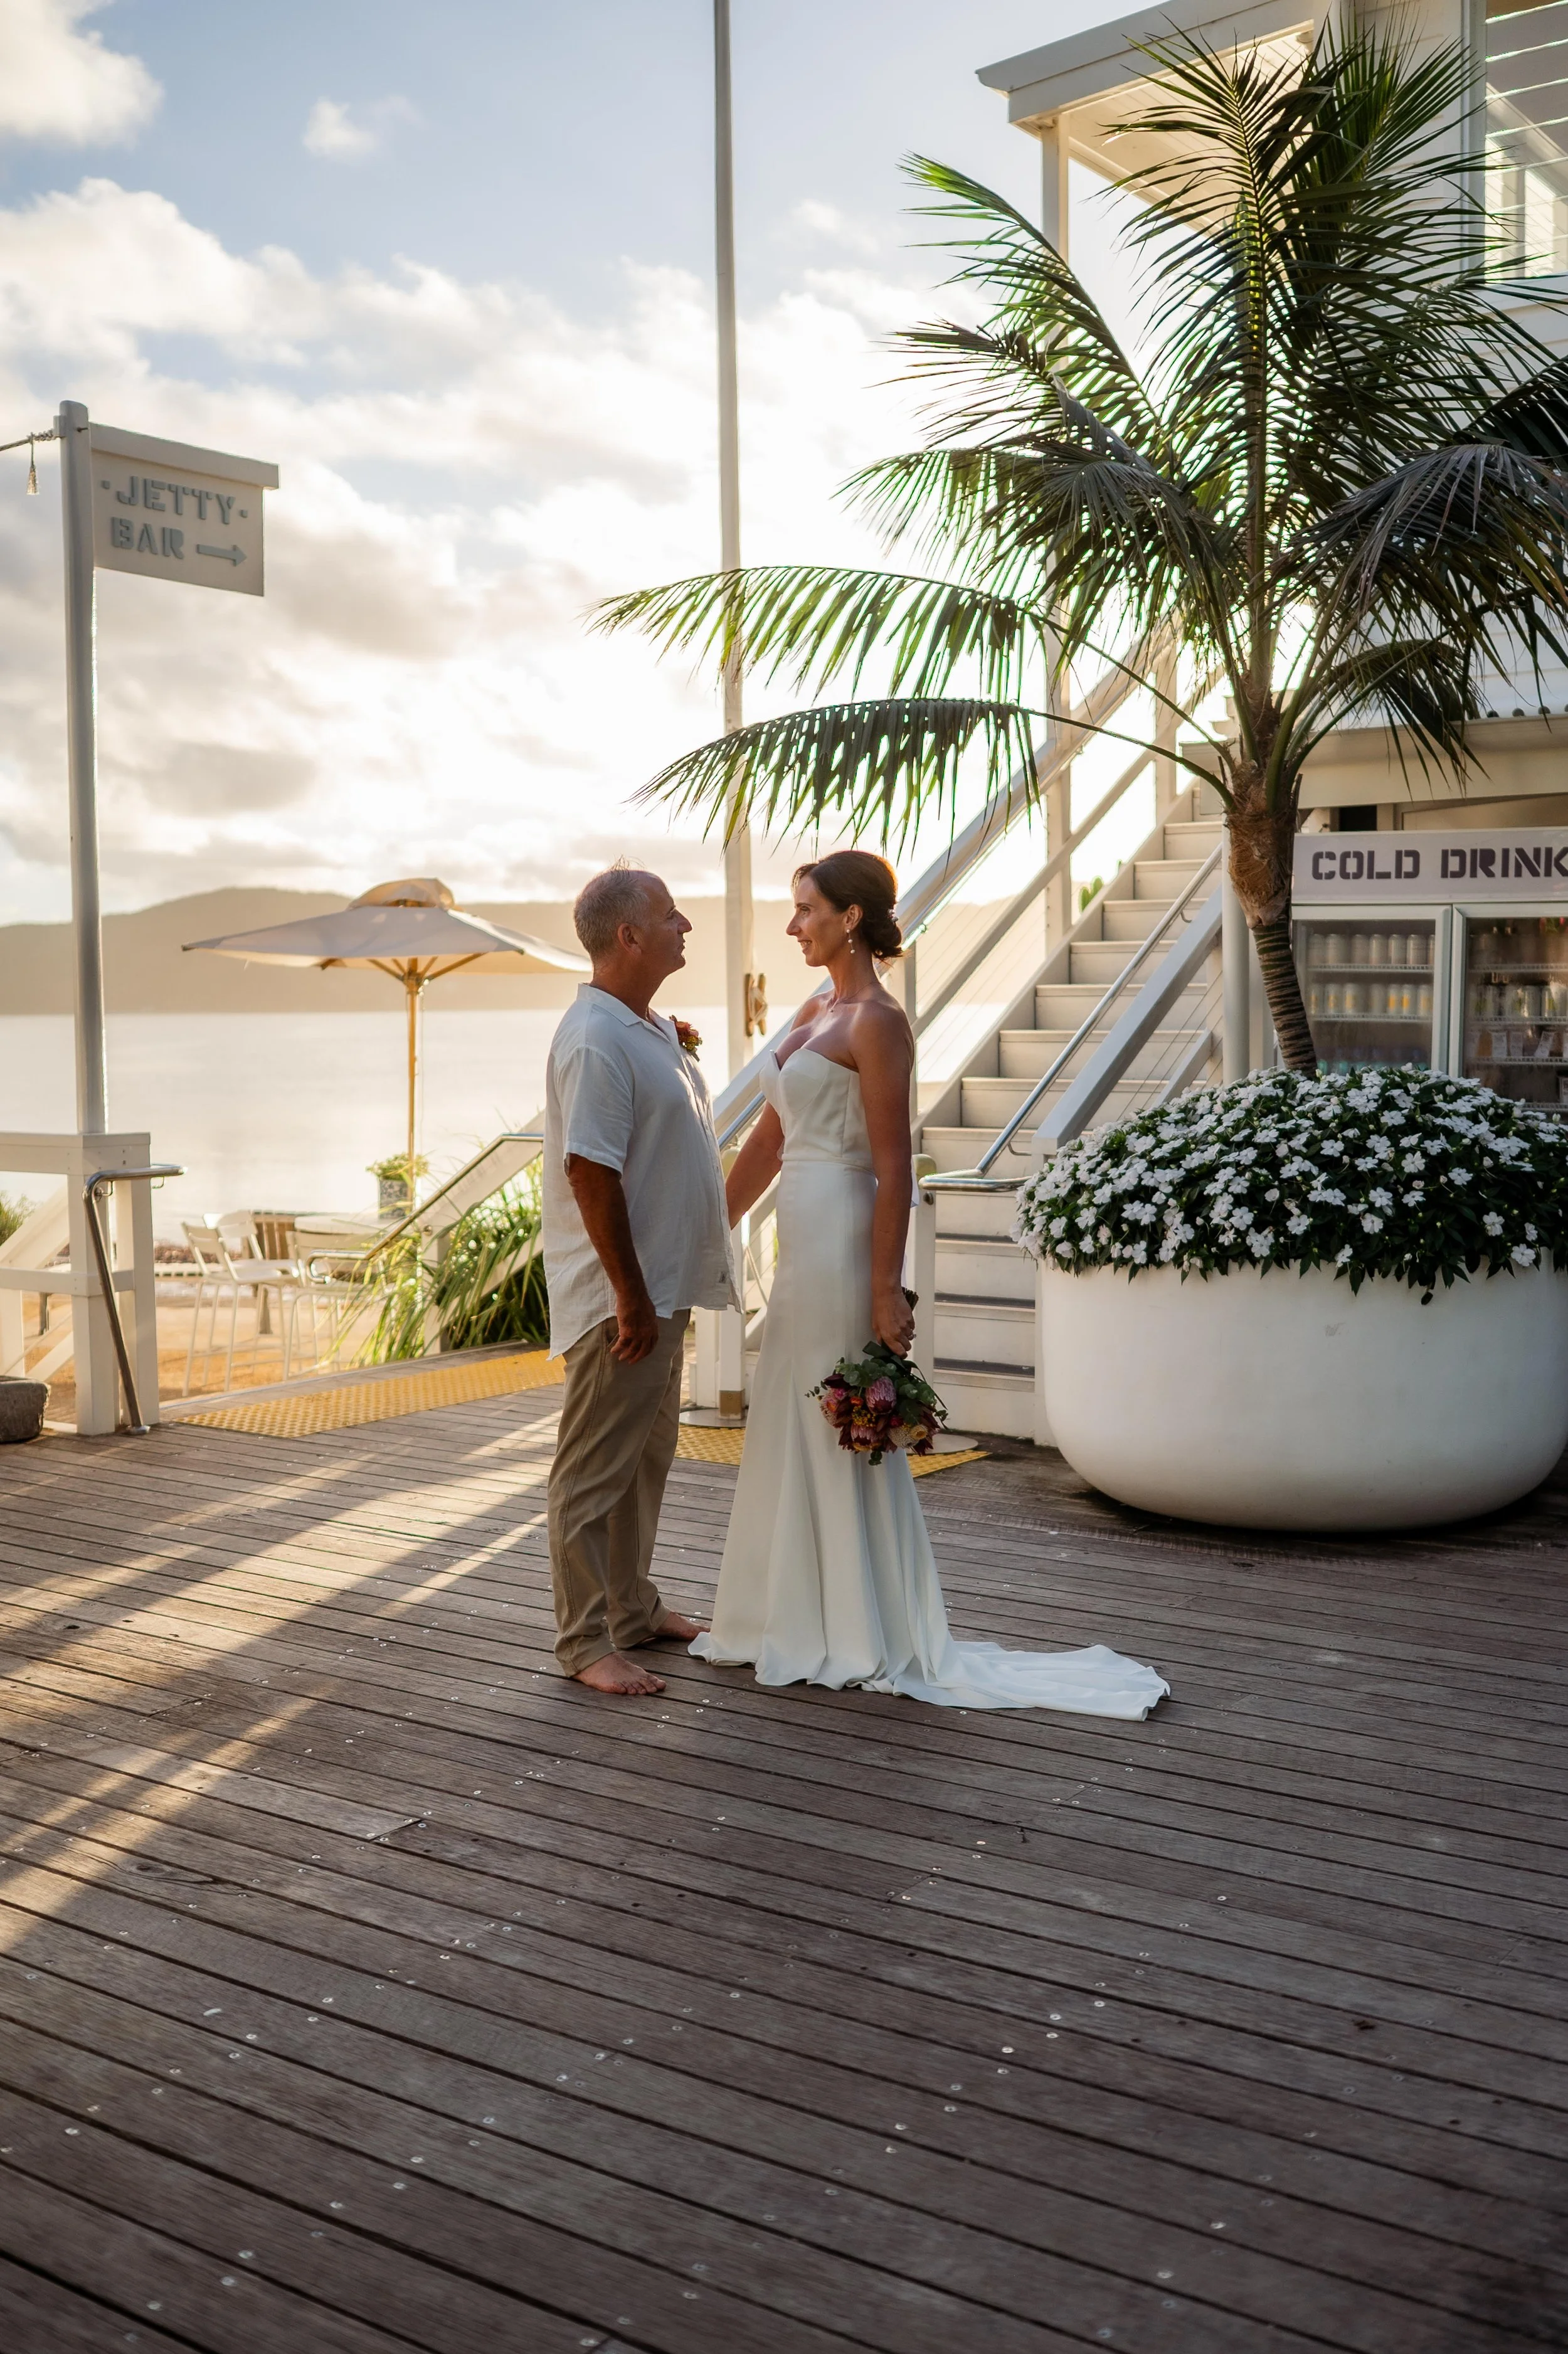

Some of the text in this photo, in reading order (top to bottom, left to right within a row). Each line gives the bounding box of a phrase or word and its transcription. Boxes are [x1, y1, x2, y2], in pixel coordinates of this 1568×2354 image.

[116, 475, 236, 524] JETTY
[111, 517, 184, 559] BAR
[1312, 847, 1568, 880] COLD DRINK
